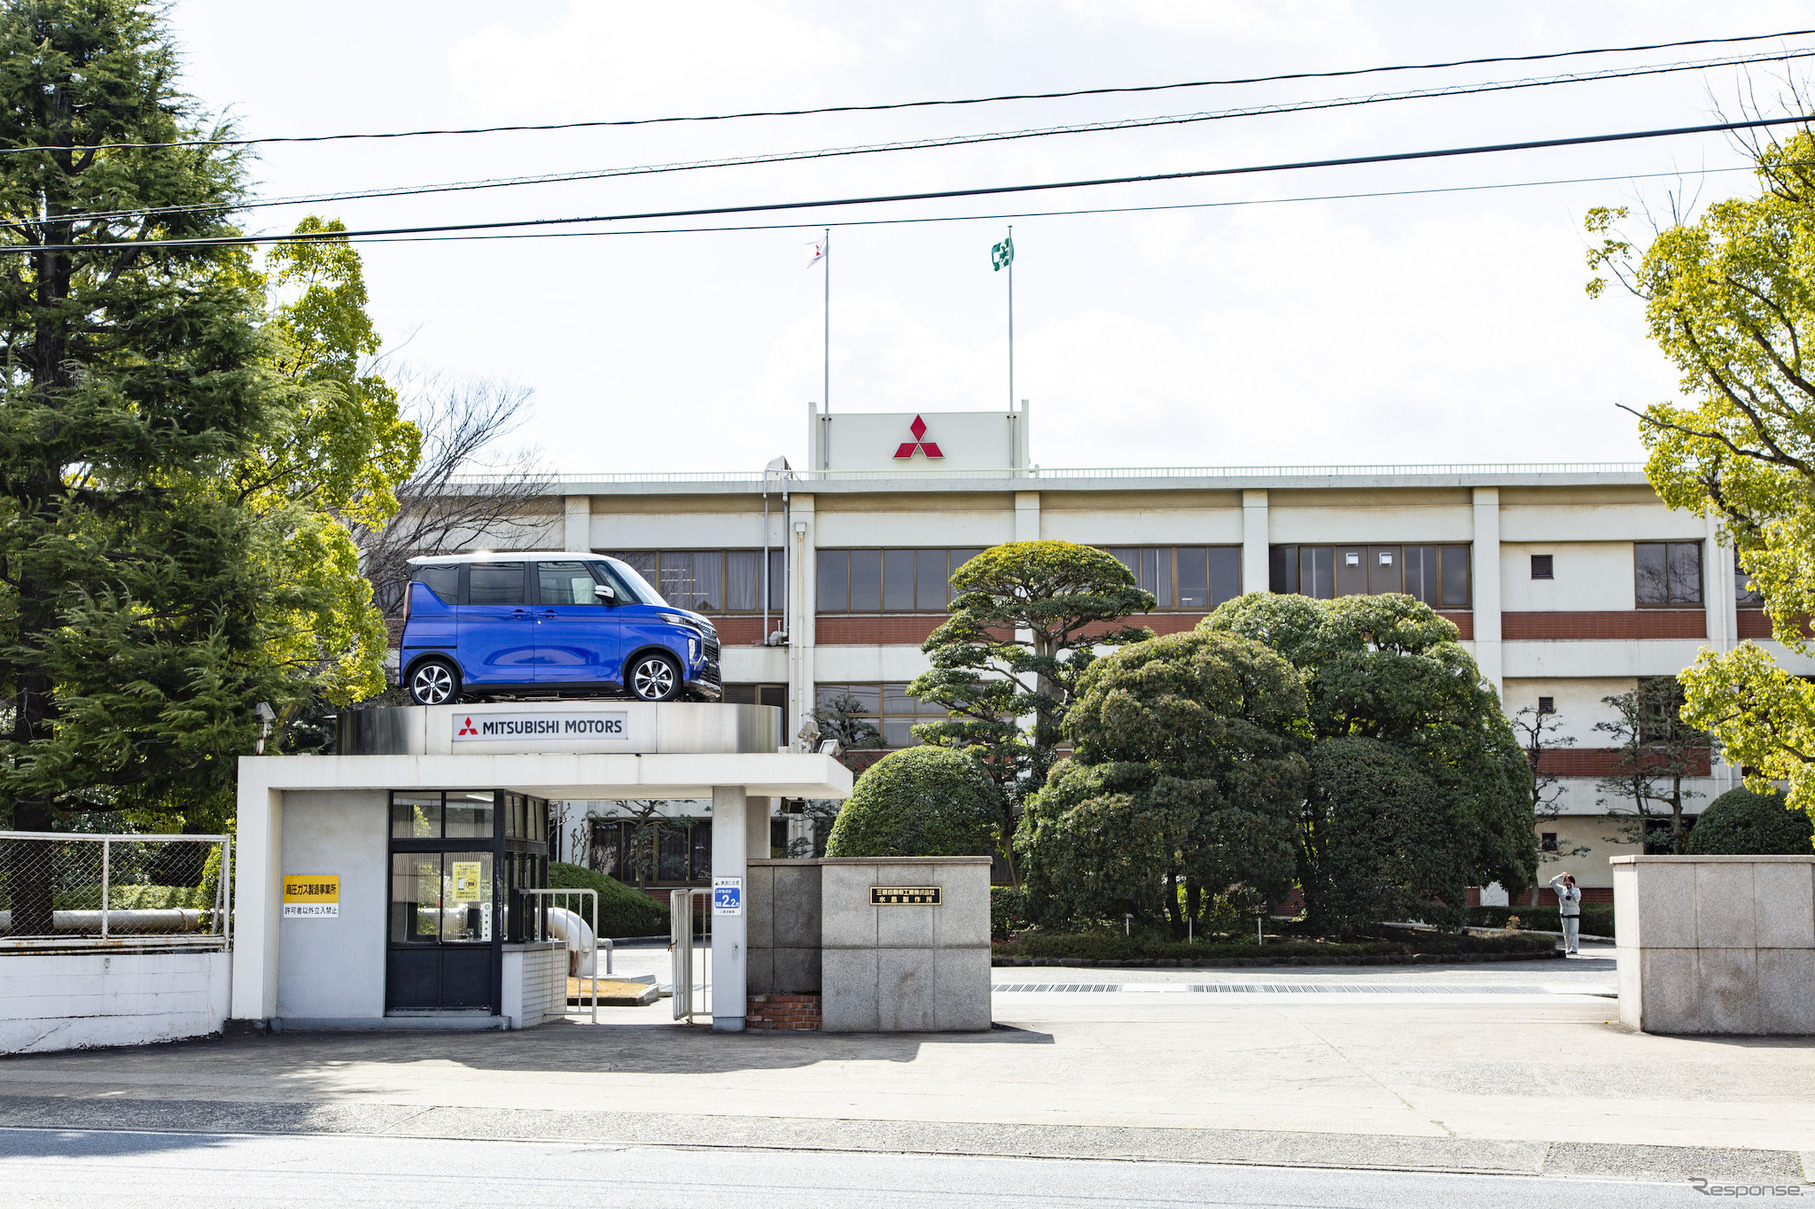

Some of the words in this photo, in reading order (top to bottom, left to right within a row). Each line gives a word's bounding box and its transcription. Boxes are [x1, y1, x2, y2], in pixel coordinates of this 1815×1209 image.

[483, 720, 560, 735] MITSUBISHI
[565, 720, 622, 734] MOTORS
[286, 883, 337, 896] 高圧ガス製造事業所
[284, 906, 338, 915] 許可者以外立入禁止
